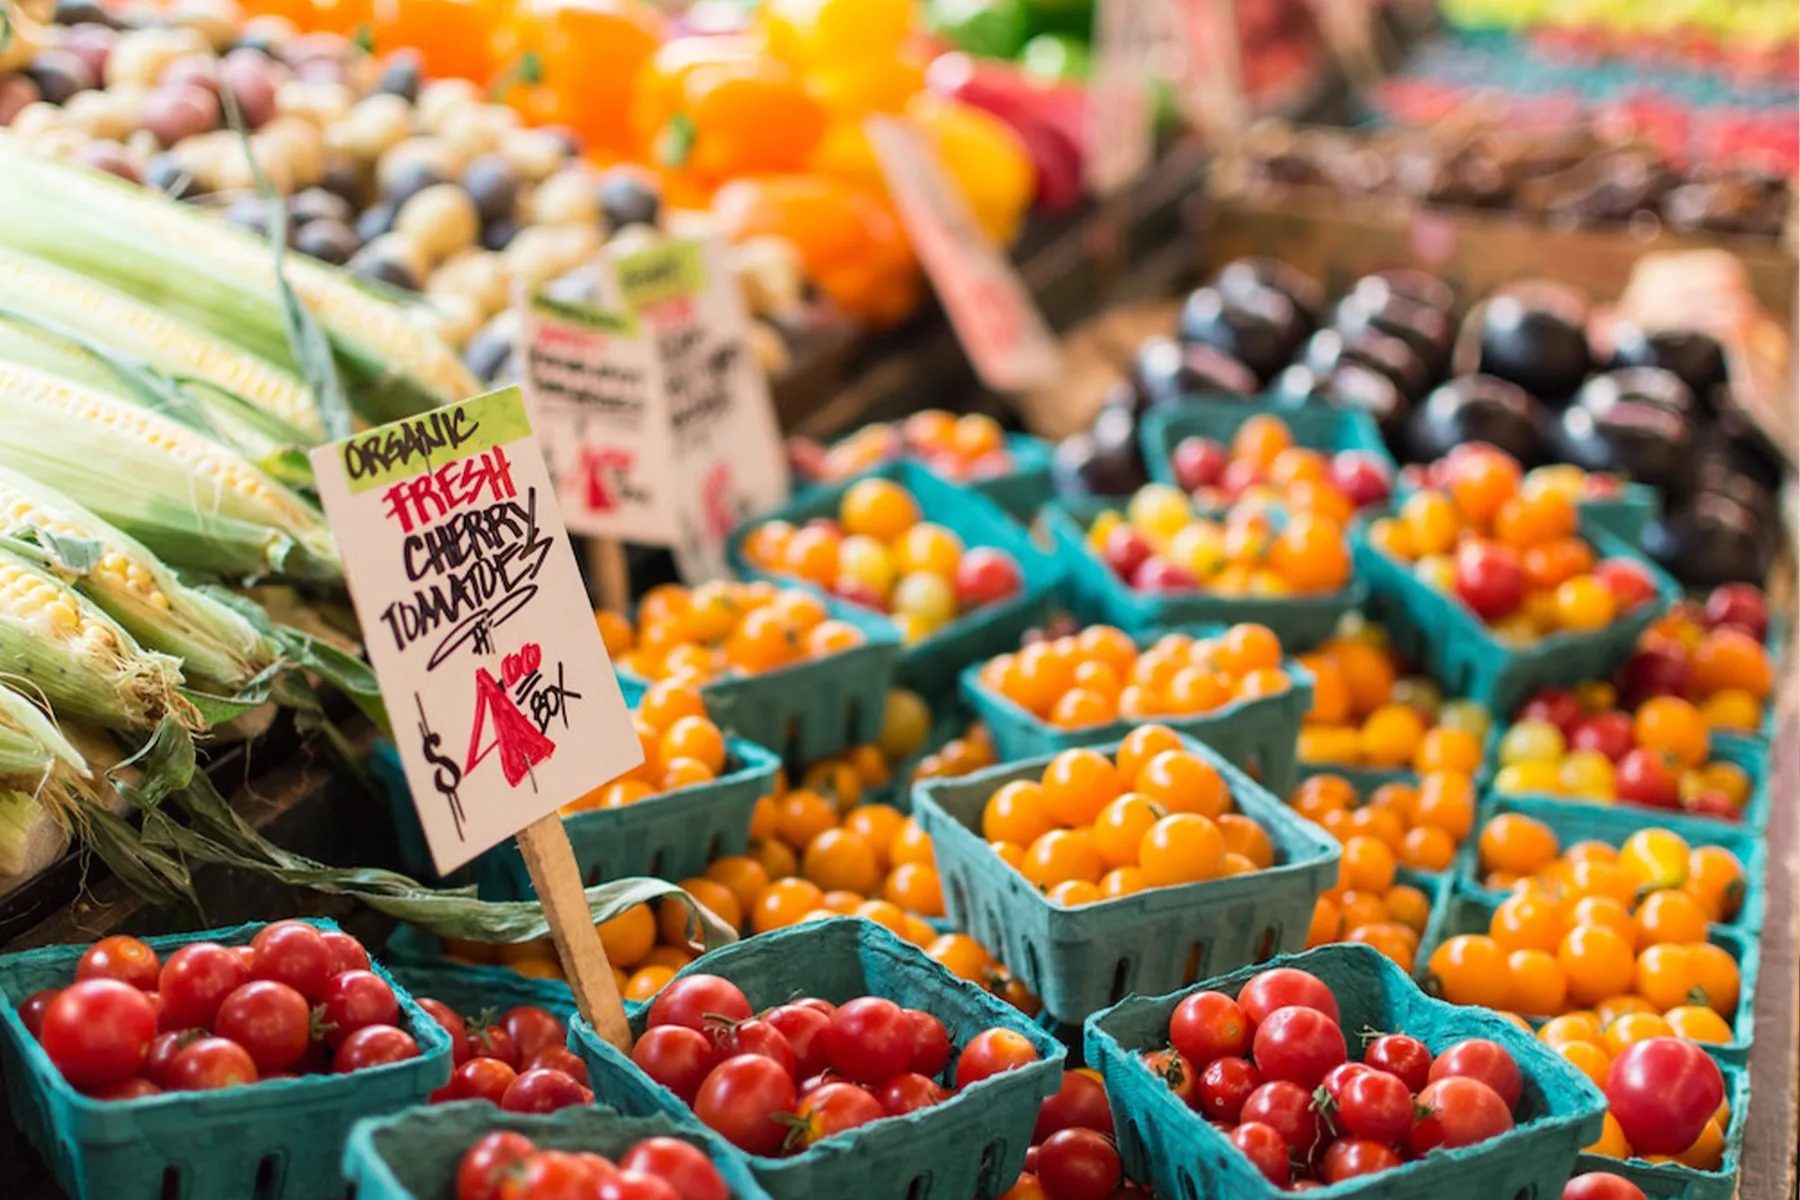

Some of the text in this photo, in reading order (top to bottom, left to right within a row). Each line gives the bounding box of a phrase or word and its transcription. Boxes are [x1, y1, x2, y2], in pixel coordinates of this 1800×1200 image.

[344, 406, 479, 480] ORGANIC
[381, 444, 517, 533] FRESH
[404, 487, 538, 582] CHERRY
[380, 536, 554, 652] TOMATOES
[530, 661, 581, 735] BOX
